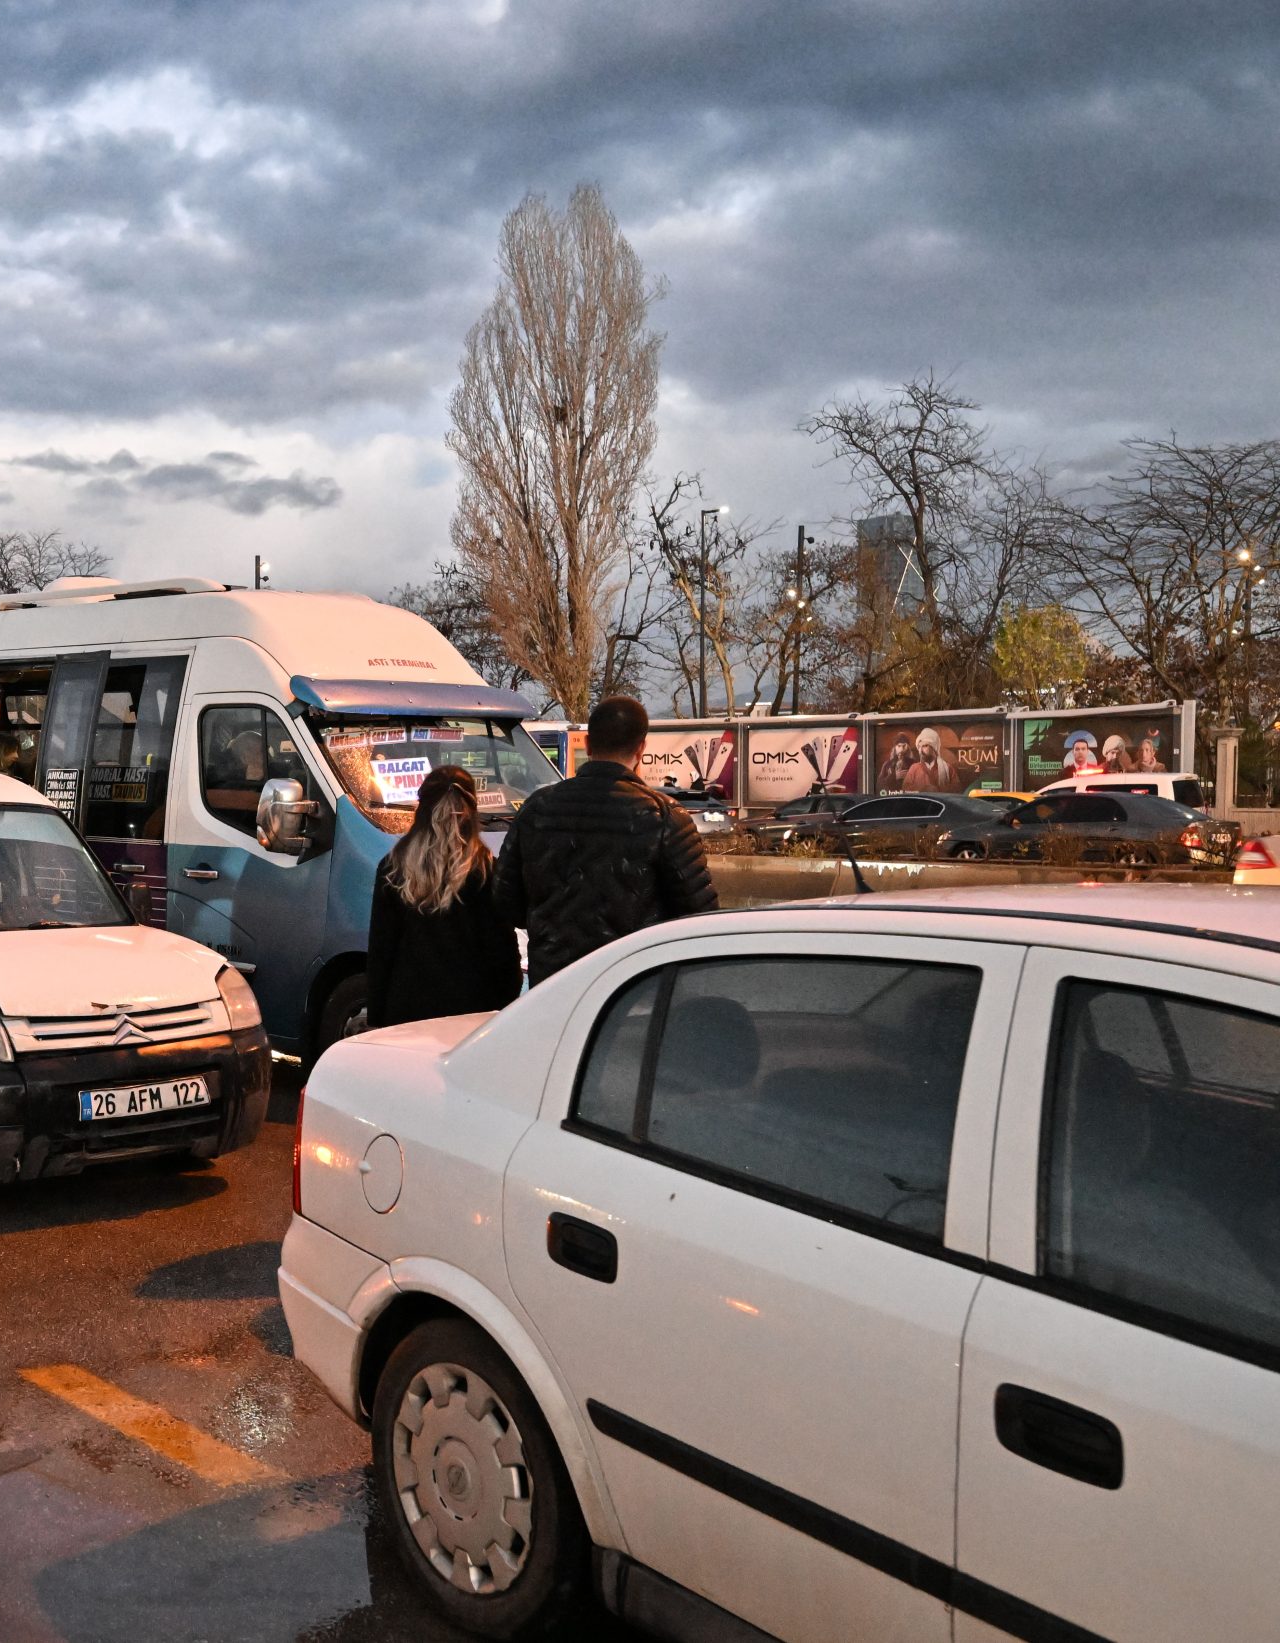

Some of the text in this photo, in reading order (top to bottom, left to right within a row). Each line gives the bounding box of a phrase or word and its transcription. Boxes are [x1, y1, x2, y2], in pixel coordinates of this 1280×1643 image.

[641, 753, 683, 765] OMIX
[752, 752, 799, 765] OMIX
[377, 760, 426, 774] BALGAT
[974, 764, 981, 773] 2
[93, 1093, 116, 1117] 26
[127, 1087, 163, 1113] AFM
[173, 1081, 205, 1106] 122
